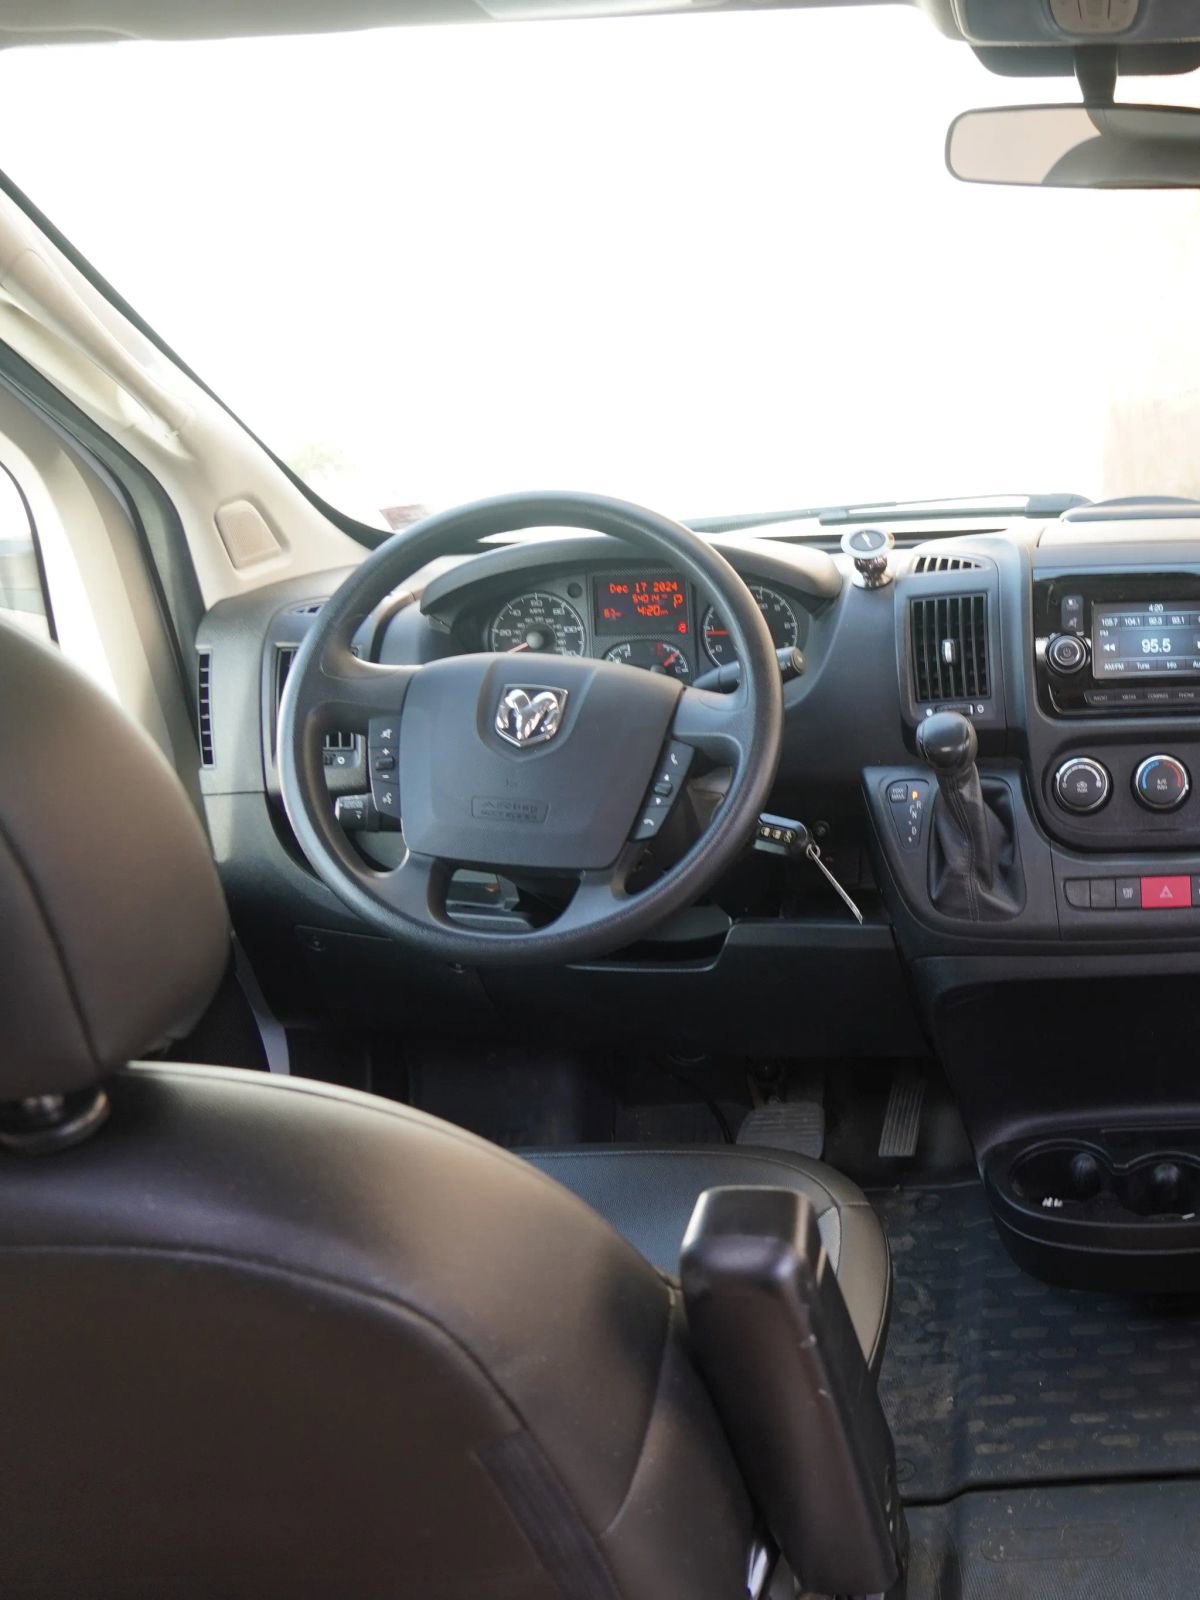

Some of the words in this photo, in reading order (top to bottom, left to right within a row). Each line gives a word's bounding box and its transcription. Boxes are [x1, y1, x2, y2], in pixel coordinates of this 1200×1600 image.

[609, 583, 628, 594] Dec
[635, 581, 648, 593] 17
[653, 580, 678, 592] 2024
[1148, 603, 1164, 612] 4:20
[1141, 637, 1171, 654] 95.5
[912, 791, 918, 800] P
[916, 800, 922, 809] R
[911, 810, 917, 819] N
[911, 826, 917, 835] D
